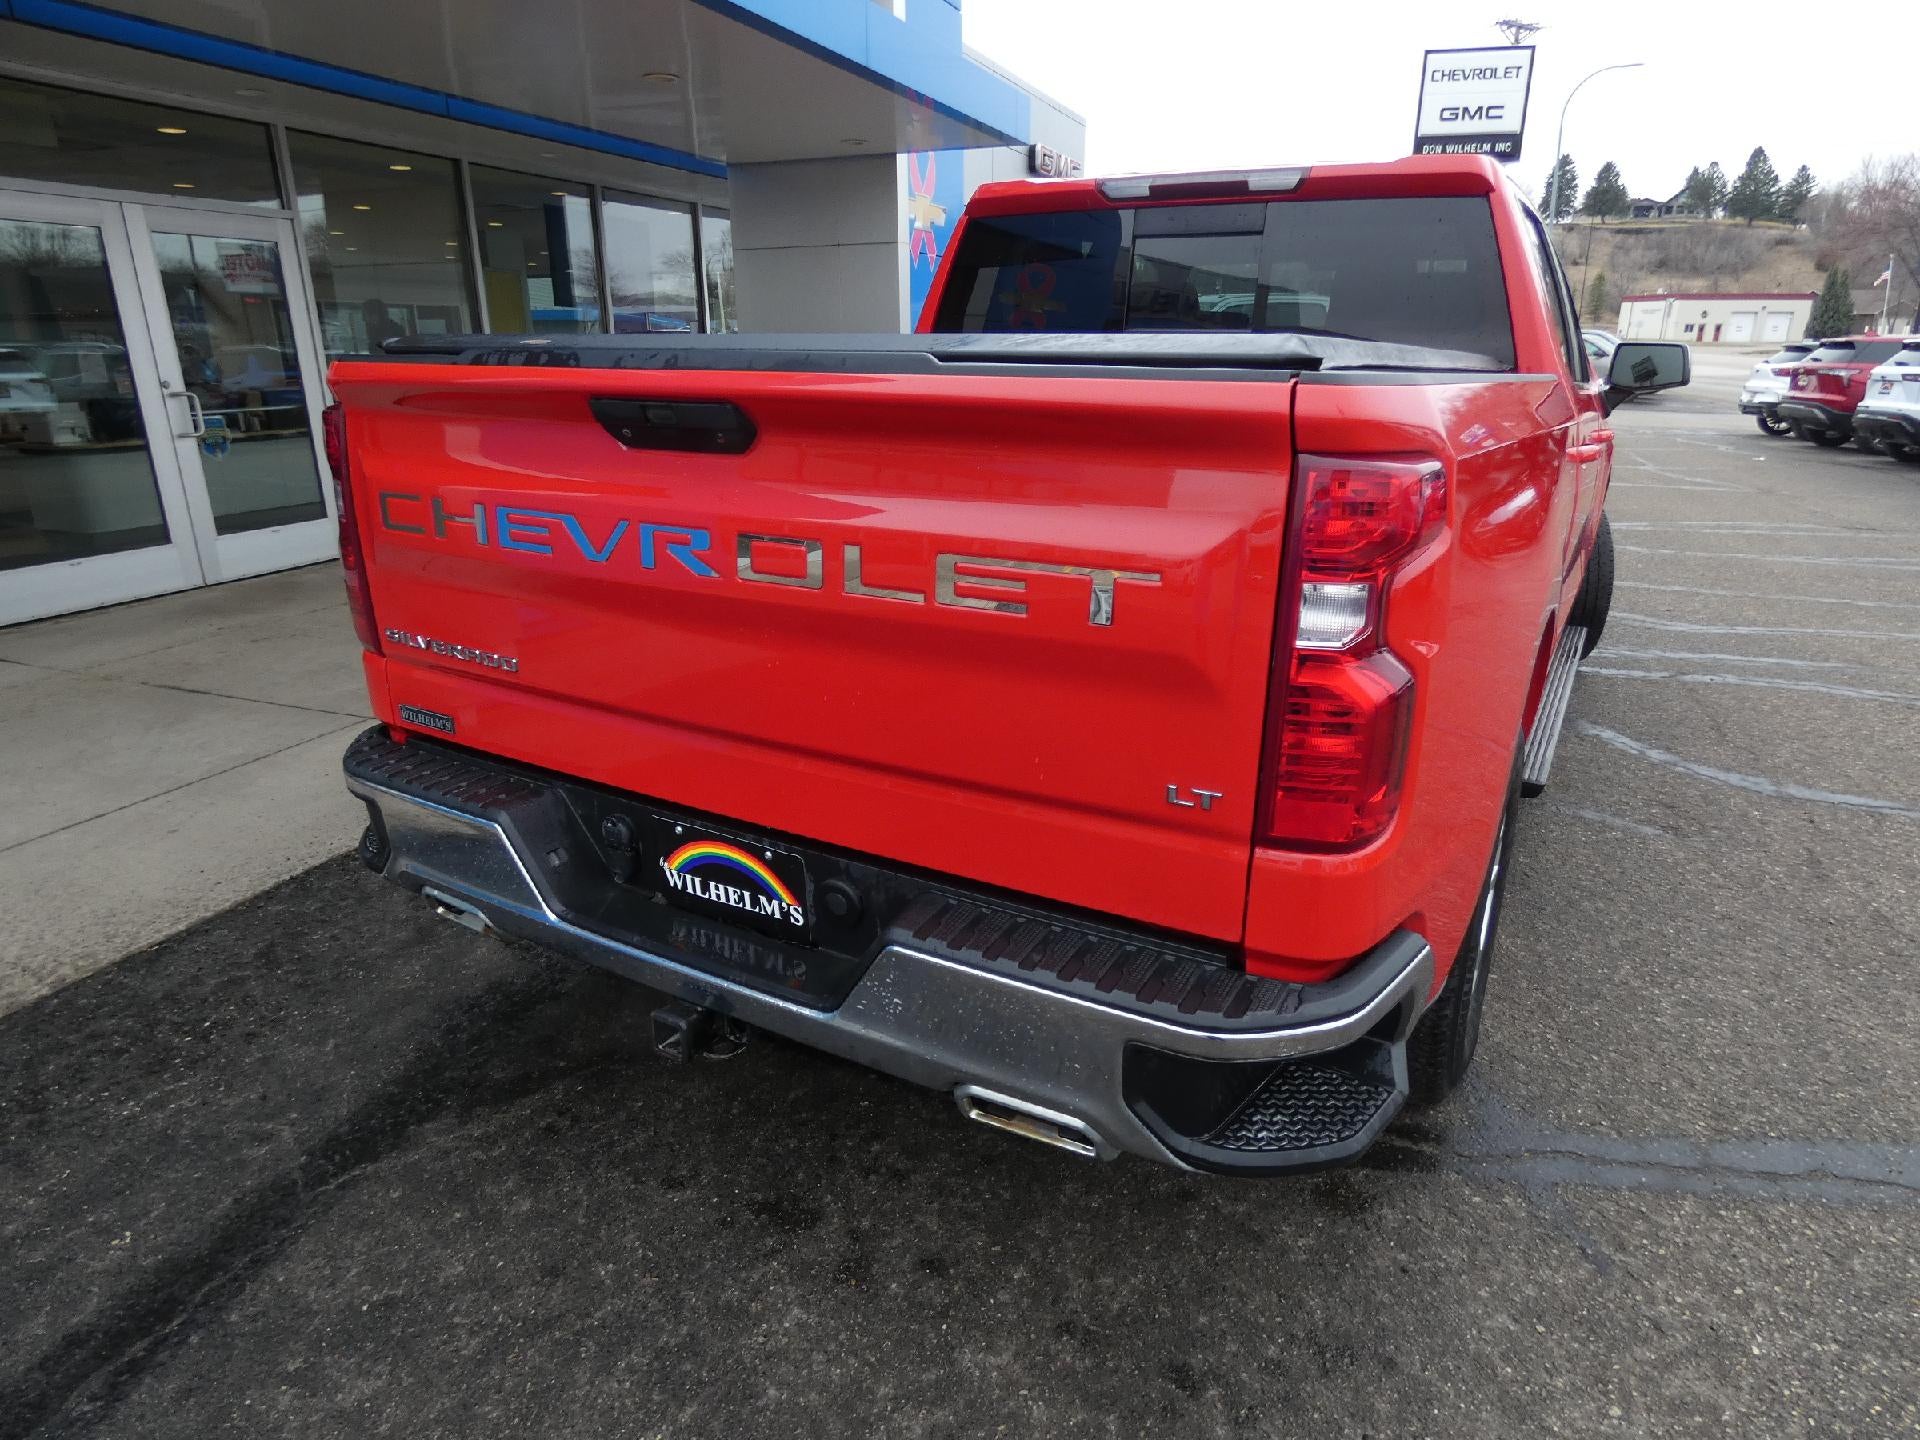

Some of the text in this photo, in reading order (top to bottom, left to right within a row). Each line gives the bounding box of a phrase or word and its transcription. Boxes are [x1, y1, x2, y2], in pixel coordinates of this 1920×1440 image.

[1431, 65, 1523, 82] CHEVROLET
[1439, 105, 1505, 121] GMC
[1445, 143, 1491, 153] WILHELM
[1495, 142, 1512, 152] INC
[379, 491, 1162, 626] CHEVROLET
[385, 628, 518, 672] SILVERADO
[401, 707, 452, 732] WILHELM'S
[1167, 784, 1223, 811] LT
[664, 868, 805, 927] WILHELM'S
